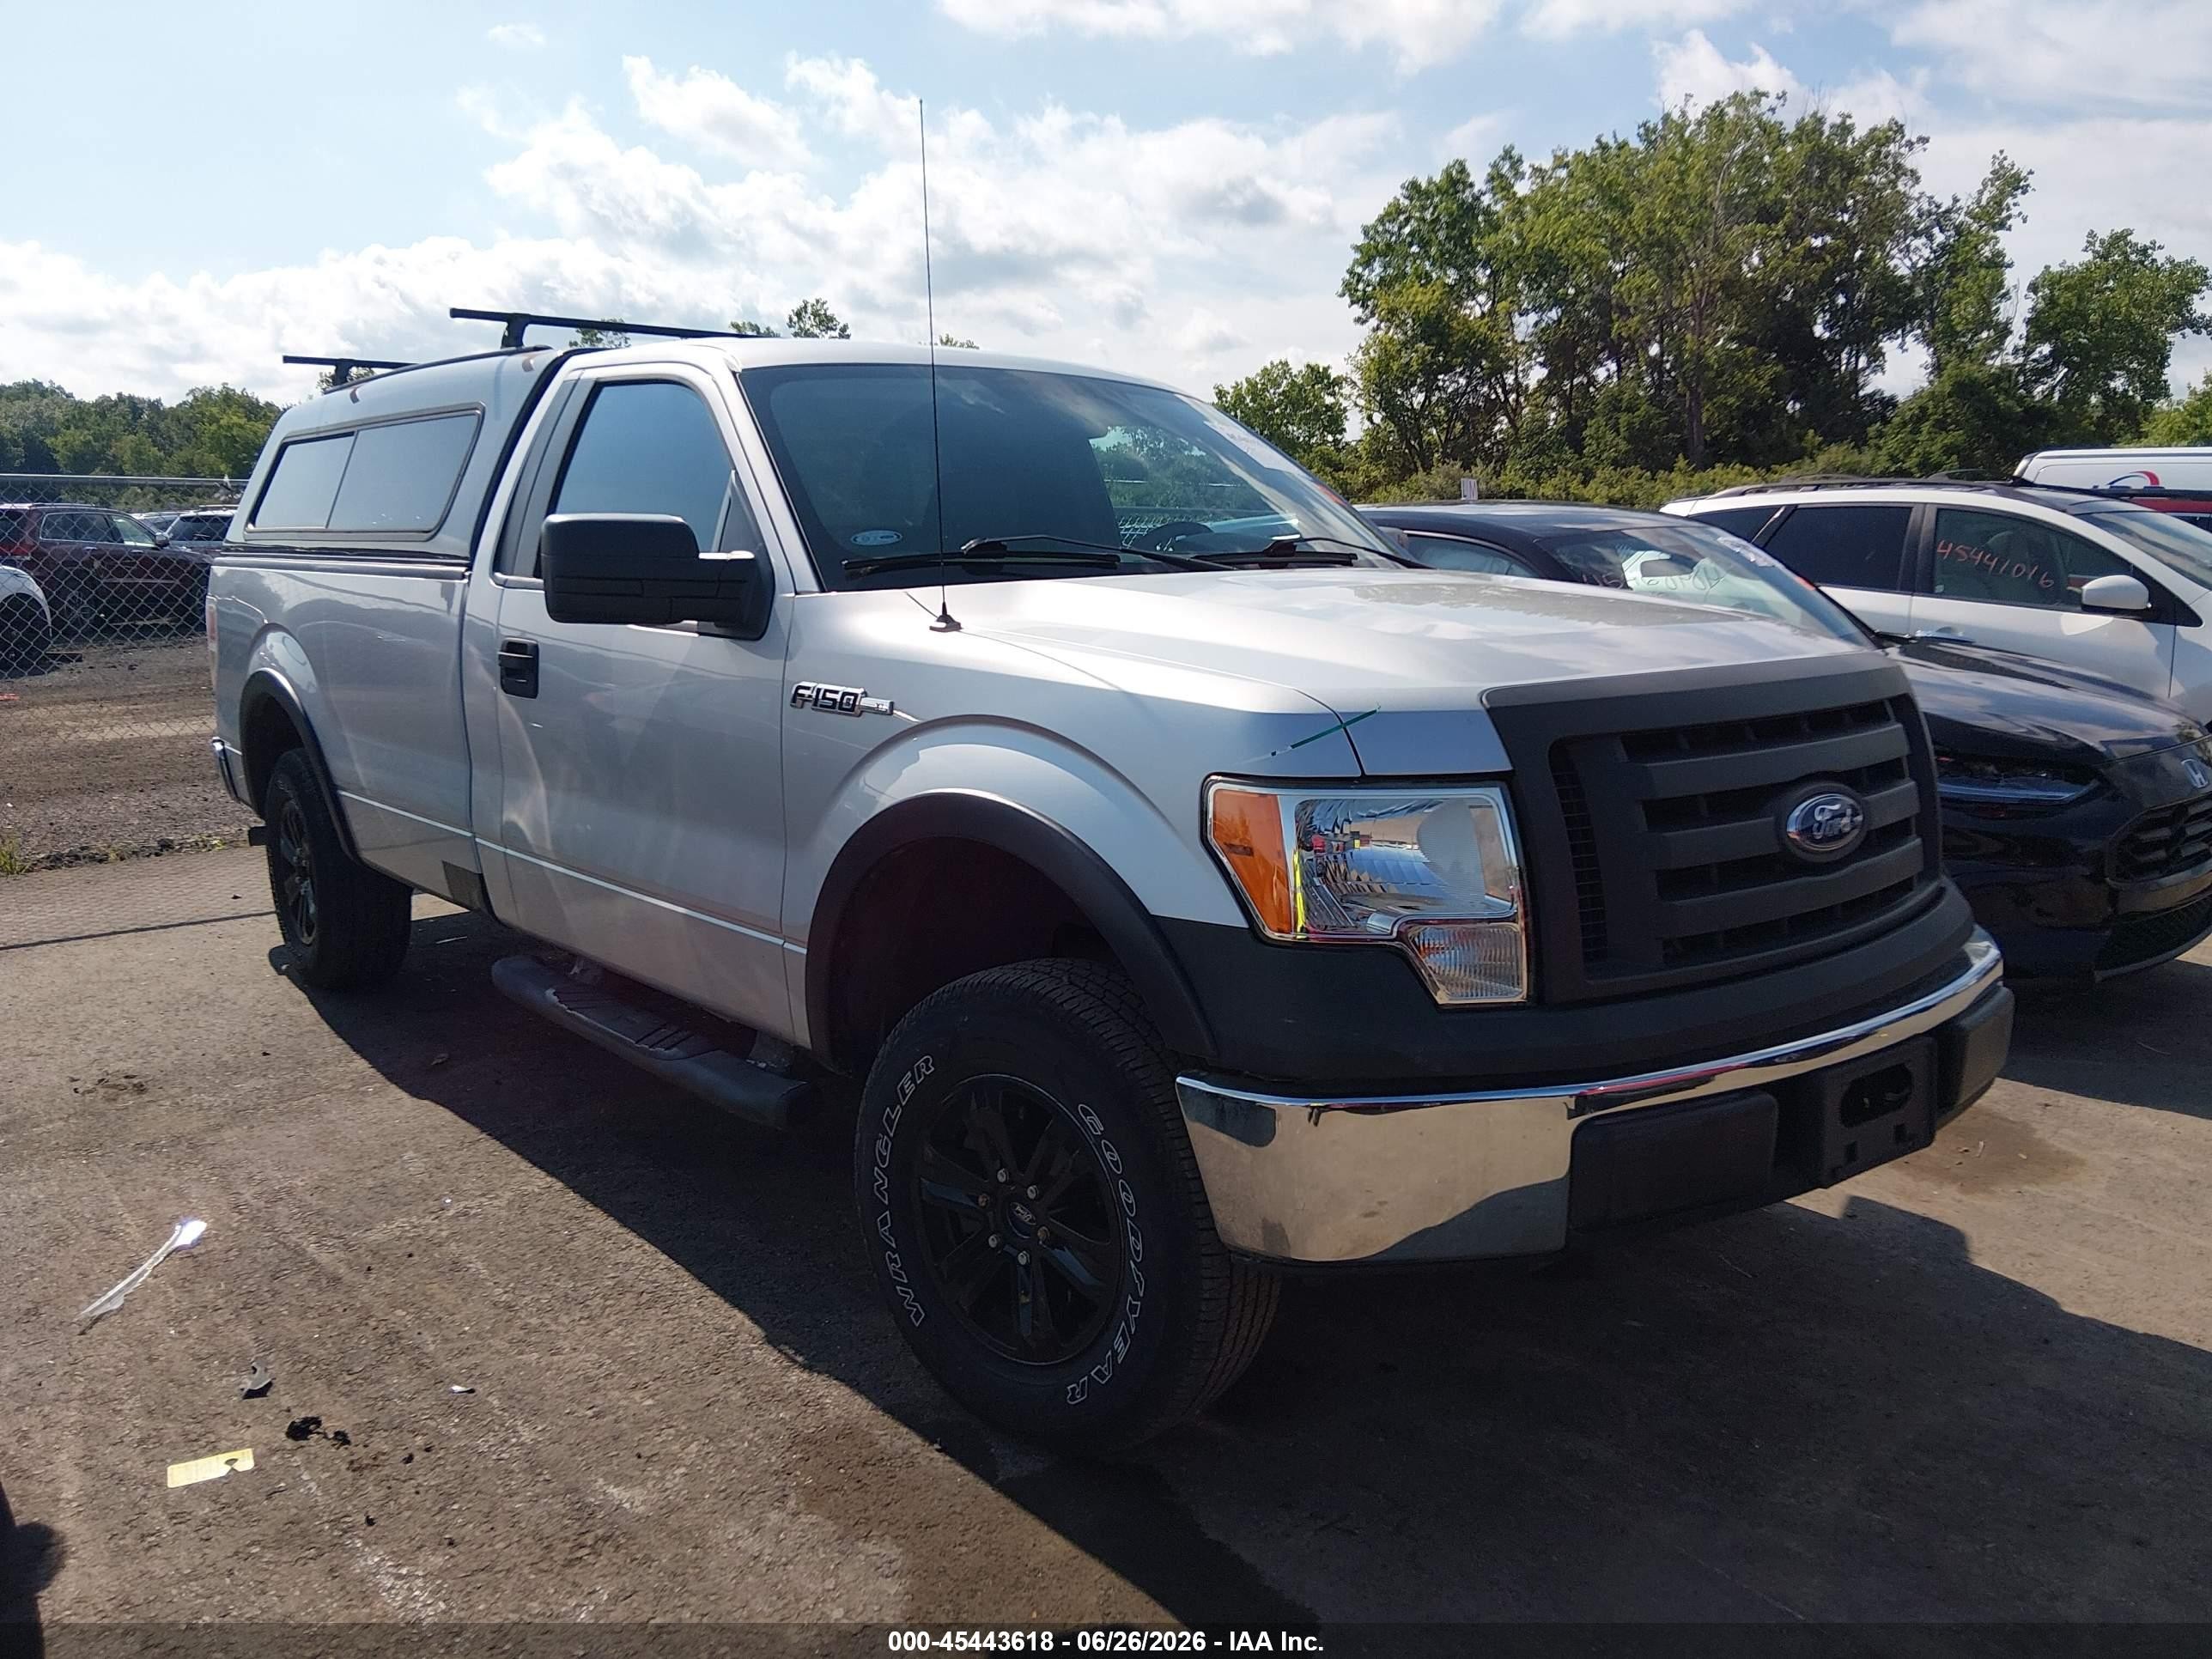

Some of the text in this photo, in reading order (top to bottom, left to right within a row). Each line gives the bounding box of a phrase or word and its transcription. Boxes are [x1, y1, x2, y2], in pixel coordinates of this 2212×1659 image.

[1936, 539, 2055, 589] 45441016
[872, 1054, 935, 1327] WRANGLER
[1066, 1103, 1145, 1405] GOODYEAR
